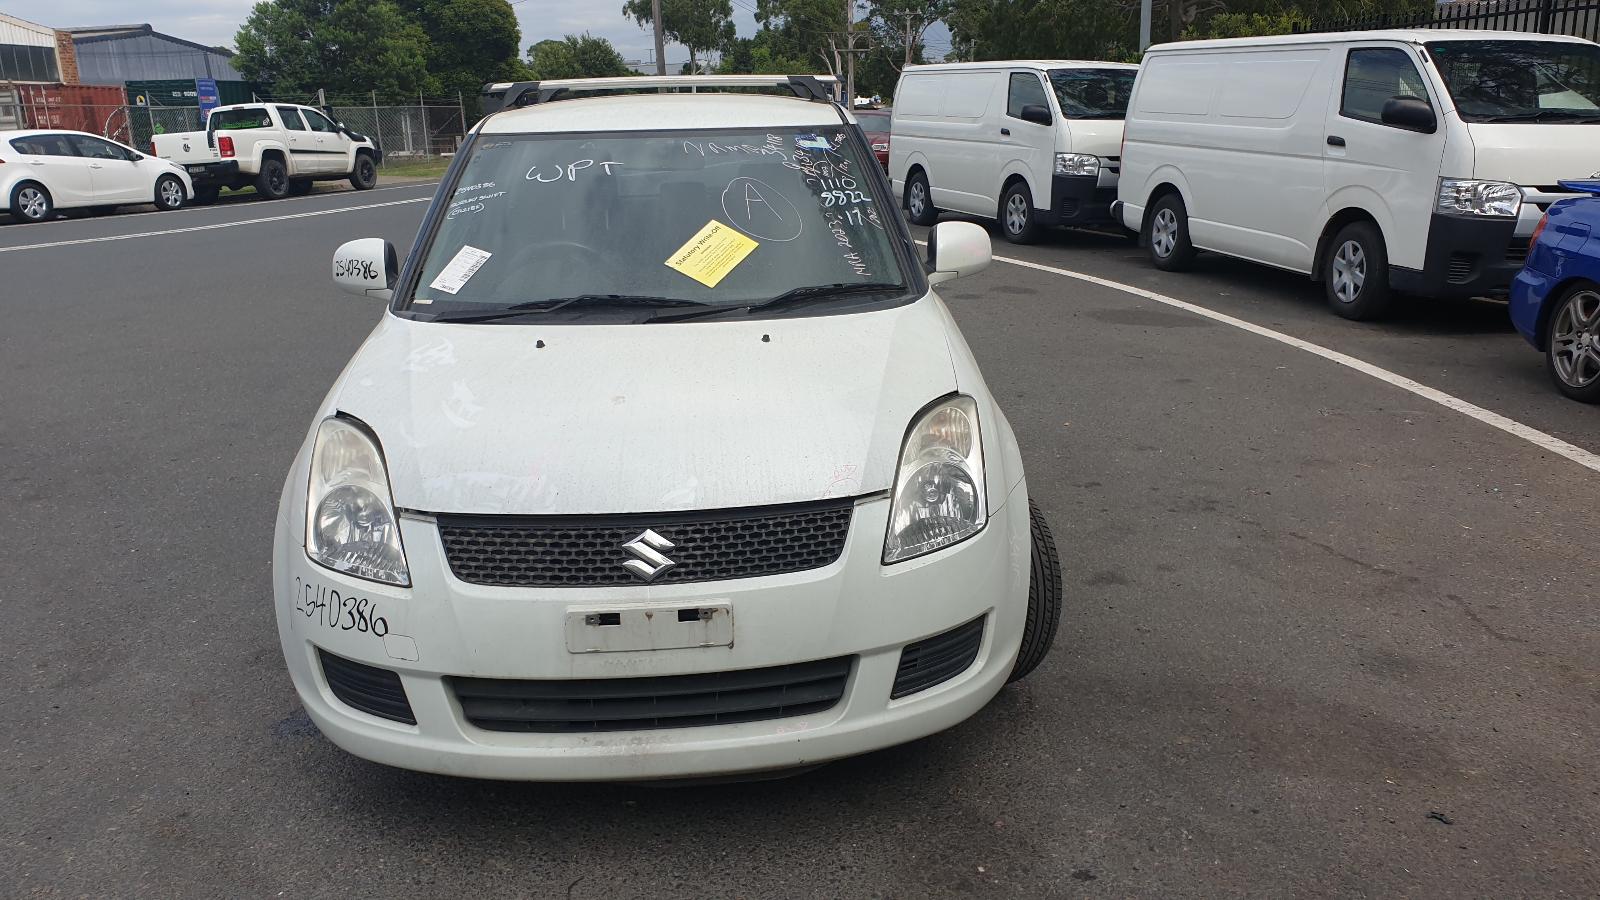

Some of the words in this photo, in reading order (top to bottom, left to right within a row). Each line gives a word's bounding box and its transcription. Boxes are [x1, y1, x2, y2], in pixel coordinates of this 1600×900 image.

[525, 159, 625, 183] WPT
[821, 190, 872, 208] 8822
[675, 244, 702, 267] Statutory
[296, 576, 389, 638] 2540386
